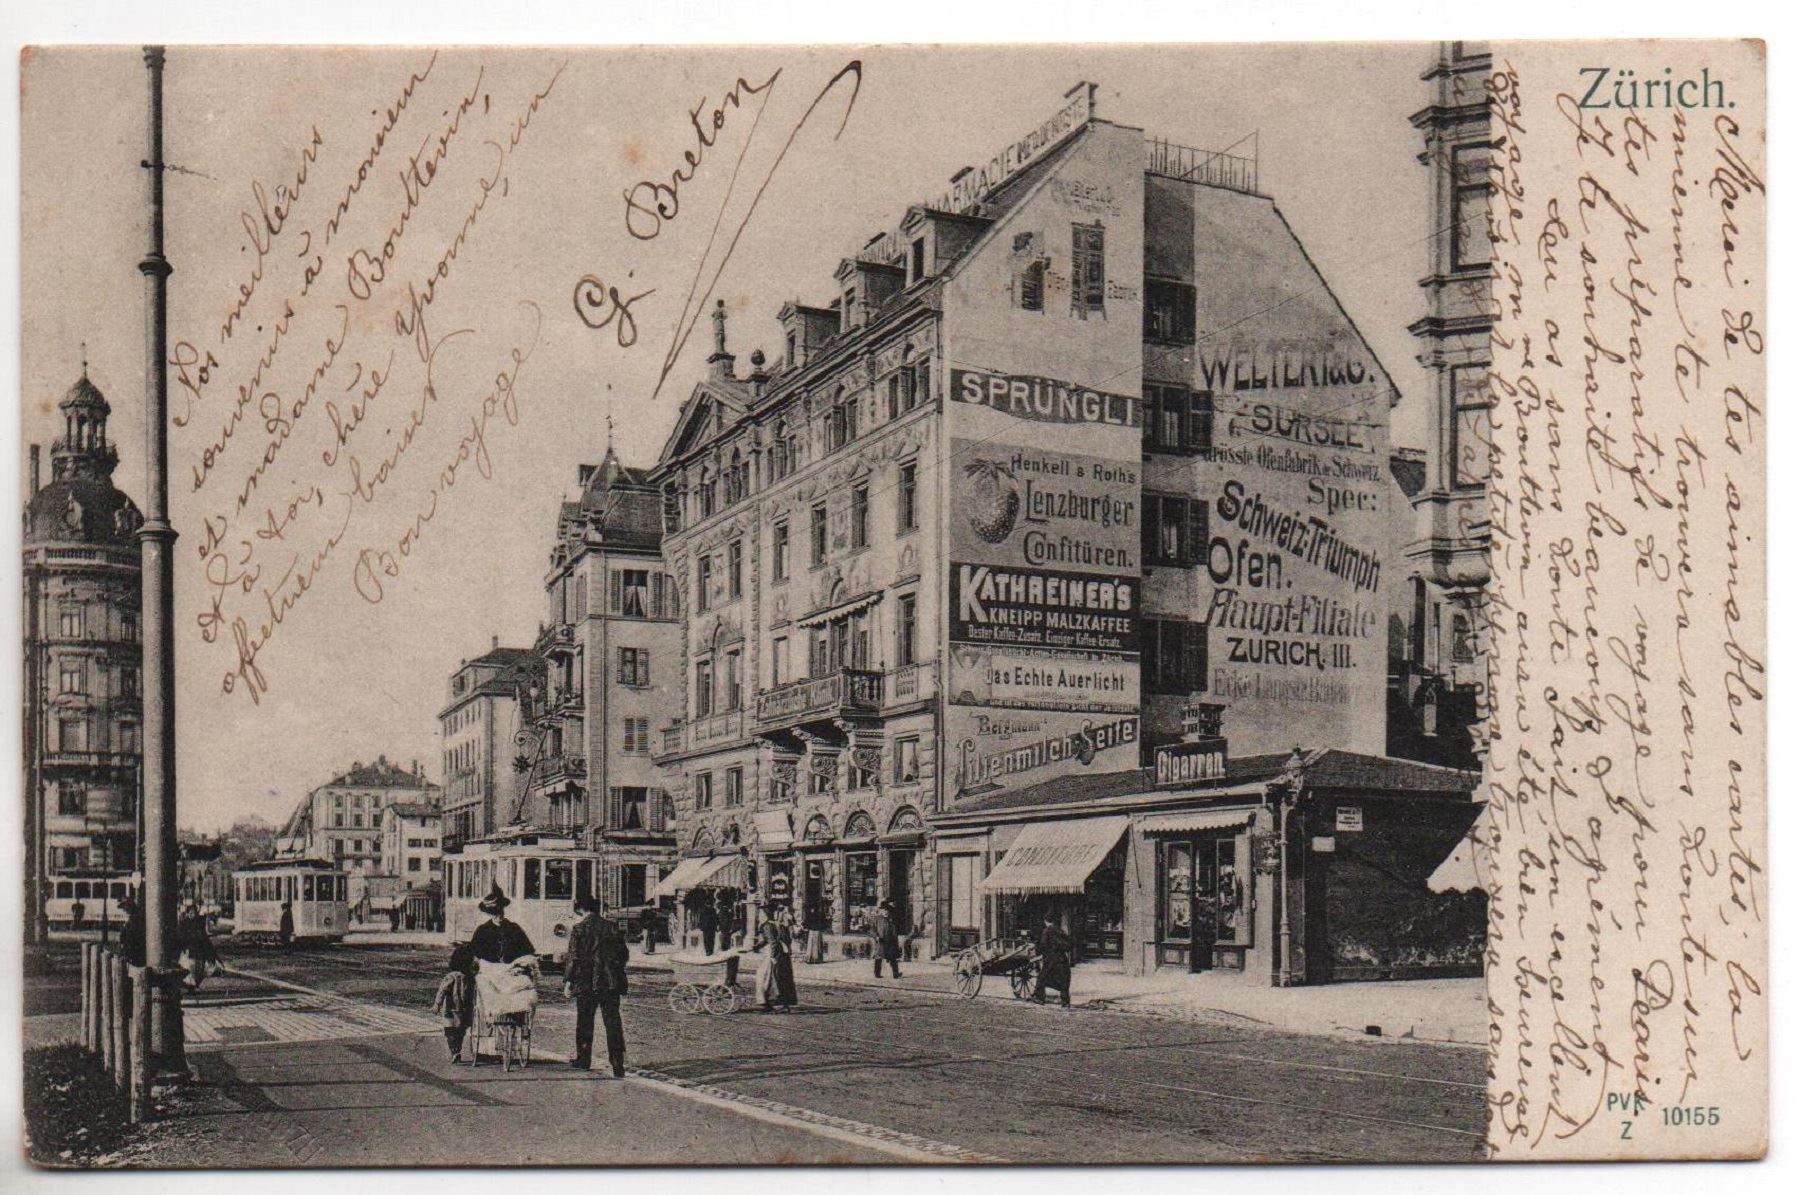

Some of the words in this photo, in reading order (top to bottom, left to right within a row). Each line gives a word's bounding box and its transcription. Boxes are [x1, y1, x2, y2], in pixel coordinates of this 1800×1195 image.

[961, 371, 1134, 427] SPRÜNGLI
[1011, 453, 1070, 477] Henkell
[1025, 480, 1135, 528] Lenzburger
[959, 565, 1132, 622] KATHREINER'S
[989, 607, 1043, 627] KNEIPP
[1046, 611, 1131, 633] MALZKAFFEE
[1014, 666, 1053, 687] Echte
[1057, 669, 1125, 692] Auerlicht
